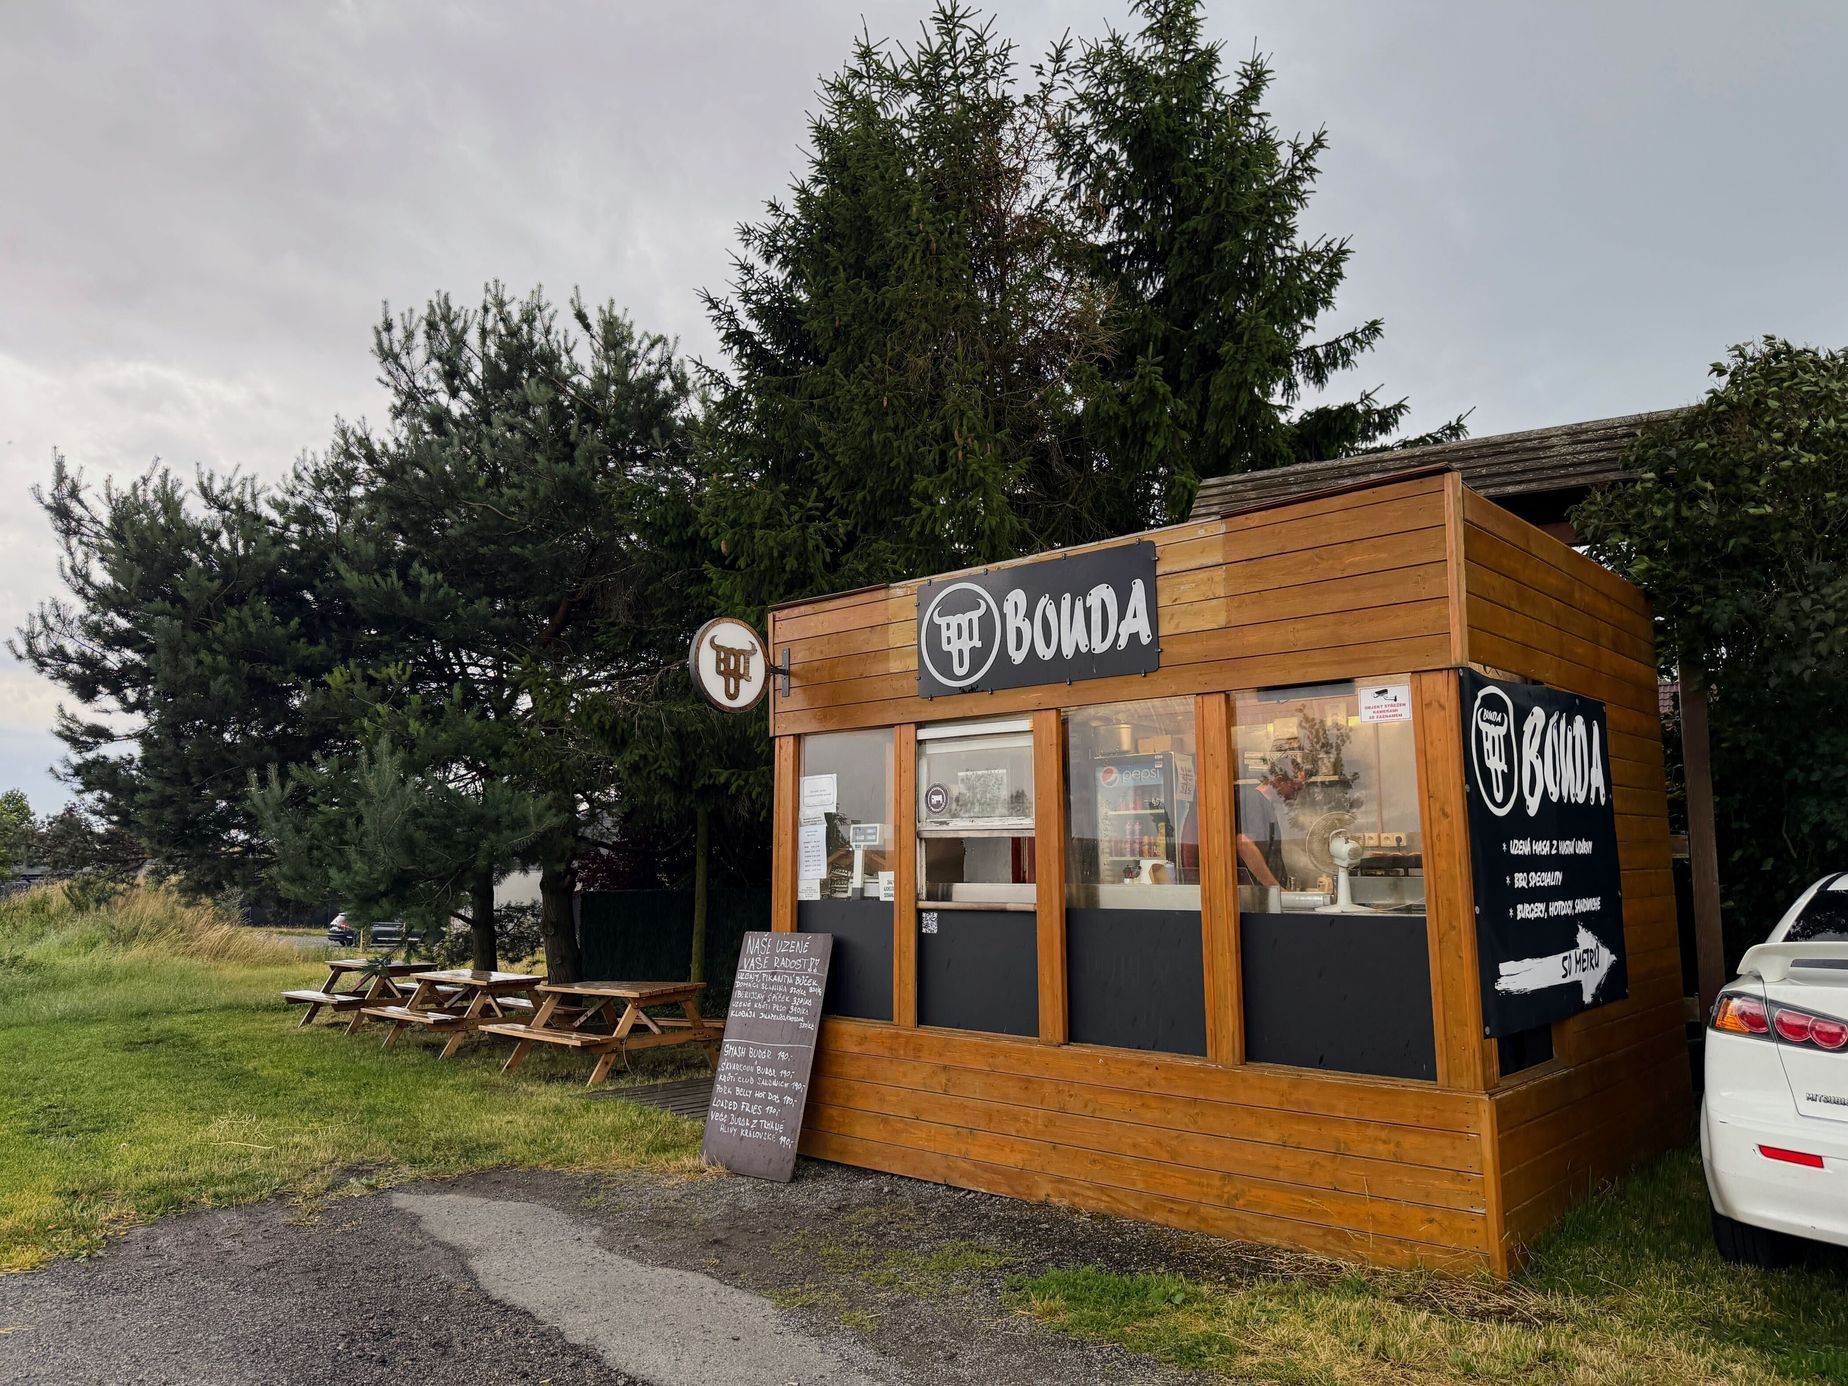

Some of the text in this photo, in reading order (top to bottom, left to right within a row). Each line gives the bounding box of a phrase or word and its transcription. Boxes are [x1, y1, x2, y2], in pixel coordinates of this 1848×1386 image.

[1003, 578, 1152, 665] BOUDA
[1482, 709, 1502, 723] BOUDA
[1522, 706, 1606, 817] BOUDA
[1122, 768, 1160, 785] pepsi
[1509, 837, 1531, 855] UZENÁ
[1532, 840, 1550, 856] MASA
[1514, 872, 1528, 889] BBQ
[1516, 902, 1547, 920] BURGERY,
[746, 933, 811, 955] NAŠE UZENÉ
[743, 955, 770, 970] VAŠE
[1562, 943, 1600, 979] 50 METRŮ
[723, 1044, 746, 1058] SMASH
[715, 1084, 732, 1094] PORK
[735, 1086, 752, 1098] BELLY
[754, 1090, 766, 1099] HOT
[712, 1097, 738, 1111] LOADED
[741, 1101, 762, 1115] FRIES
[751, 1119, 758, 1128] Z
